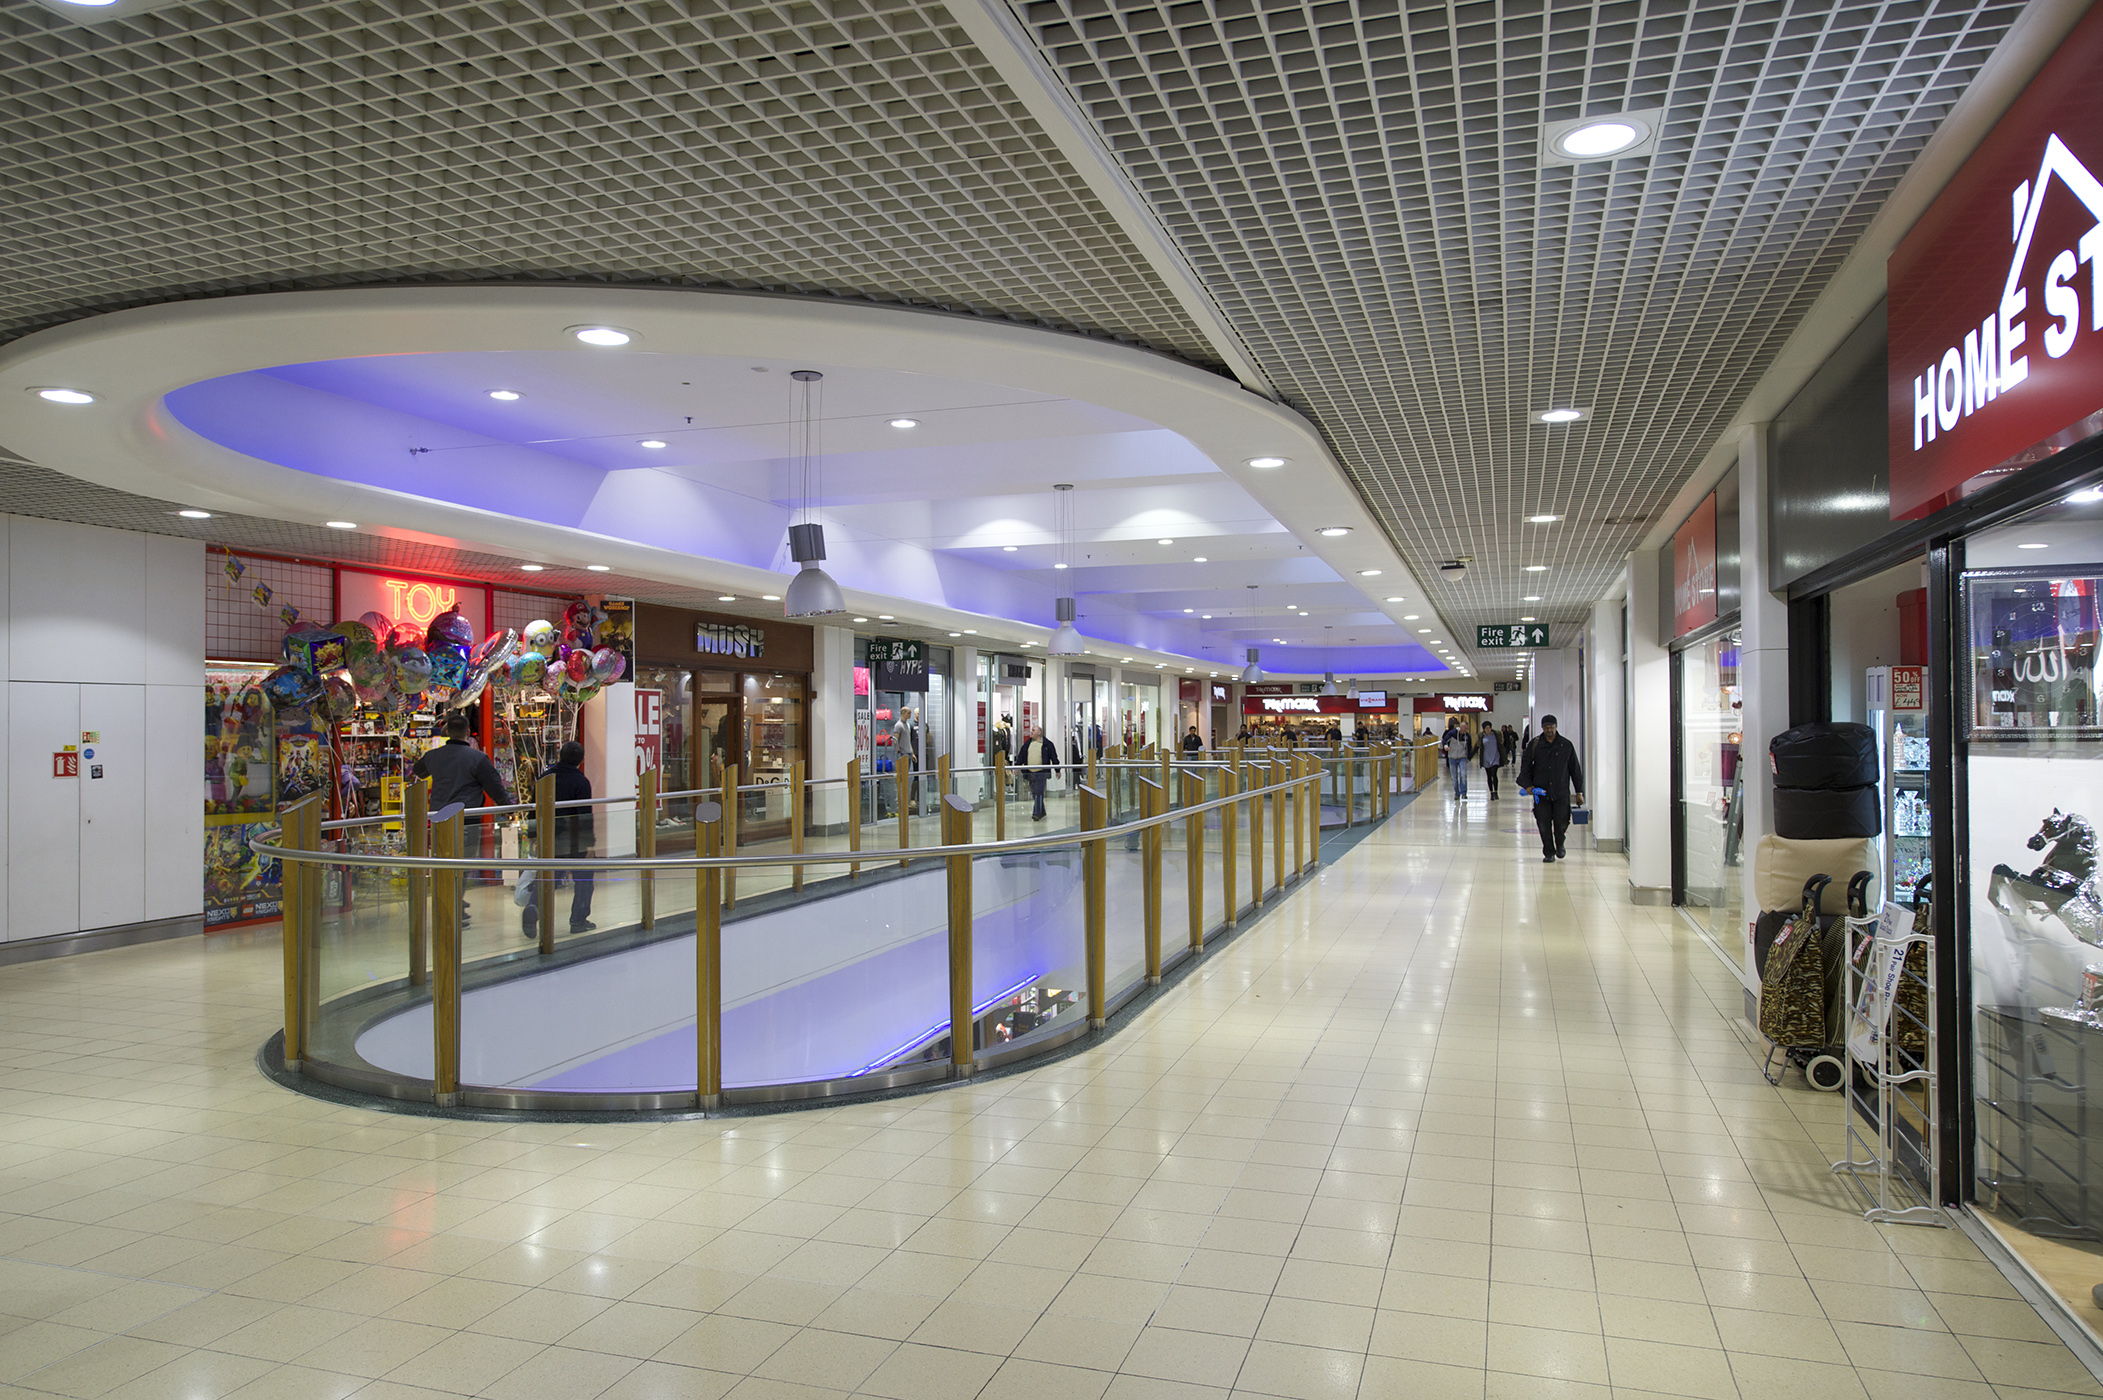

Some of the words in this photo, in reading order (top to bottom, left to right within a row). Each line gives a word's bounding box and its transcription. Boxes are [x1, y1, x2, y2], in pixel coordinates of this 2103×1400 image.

[1914, 286, 2029, 451] HOME
[385, 580, 455, 623] TOY
[1481, 627, 1504, 637] Fire
[1481, 636, 1504, 646] exit
[870, 644, 887, 652] Fire
[870, 651, 887, 660] exit
[636, 694, 660, 734] LE
[1893, 948, 1904, 960] 21
[1885, 973, 1895, 990] Shoe
